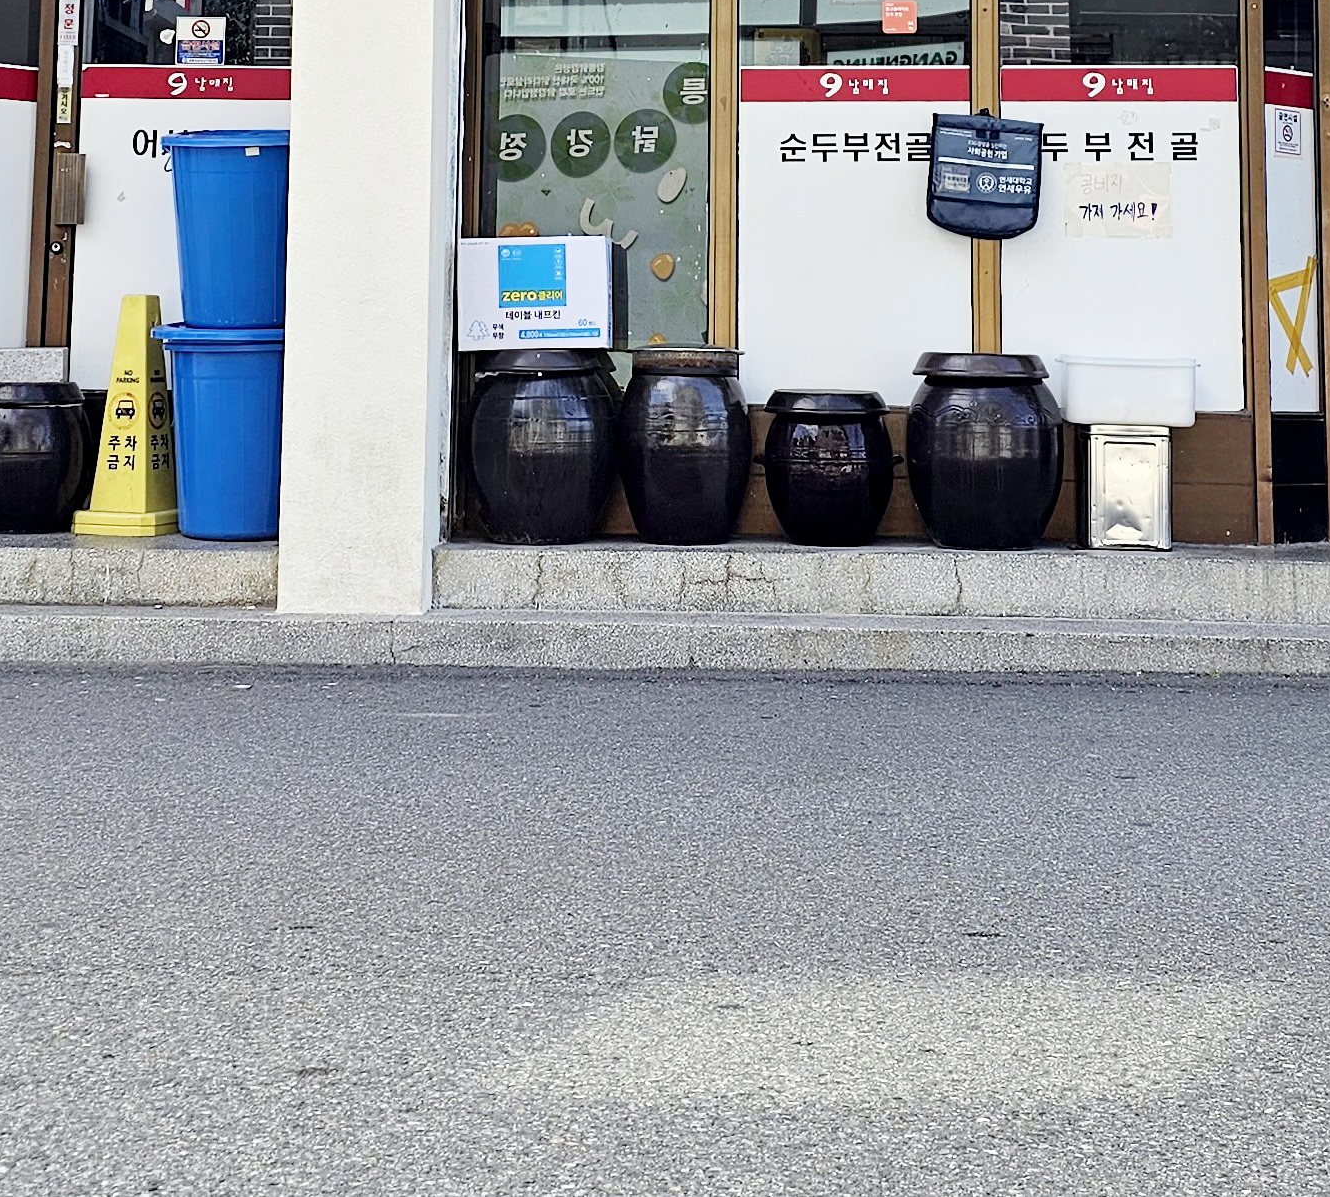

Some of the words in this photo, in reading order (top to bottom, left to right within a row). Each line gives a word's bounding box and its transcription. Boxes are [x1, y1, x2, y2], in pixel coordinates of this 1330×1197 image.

[778, 132, 932, 163] 순두부전골
[1109, 201, 1158, 222] 가세요!
[107, 435, 138, 451] 주차
[106, 454, 136, 471] 금지
